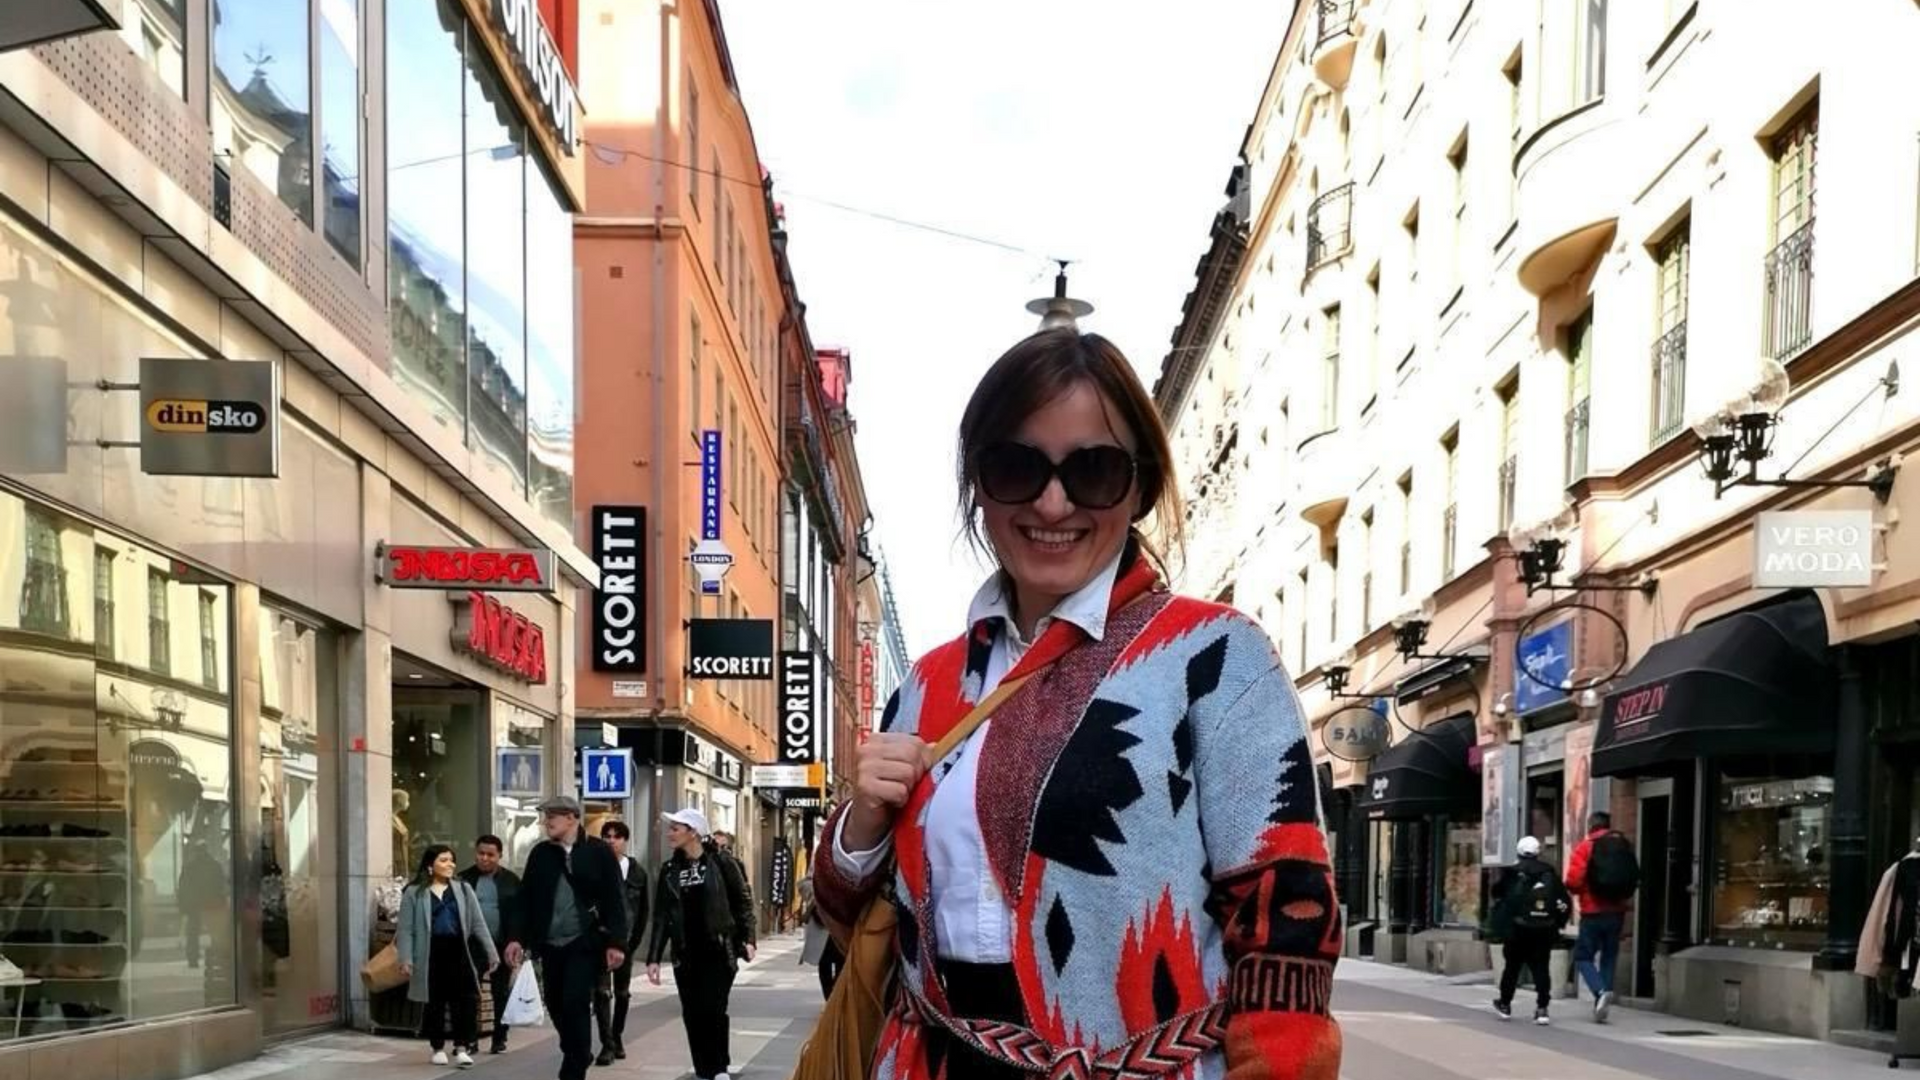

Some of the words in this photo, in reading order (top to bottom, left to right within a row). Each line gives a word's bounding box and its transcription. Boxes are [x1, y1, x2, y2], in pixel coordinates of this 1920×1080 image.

[707, 434, 716, 538] RESTAURANG
[1771, 526, 1859, 546] VERO
[693, 555, 731, 563] LONDON
[1764, 552, 1864, 572] MODA
[603, 512, 635, 664] SCORETT
[693, 656, 771, 675] SCORETT
[786, 656, 809, 758] SCORETT
[786, 798, 820, 807] SCORETT
